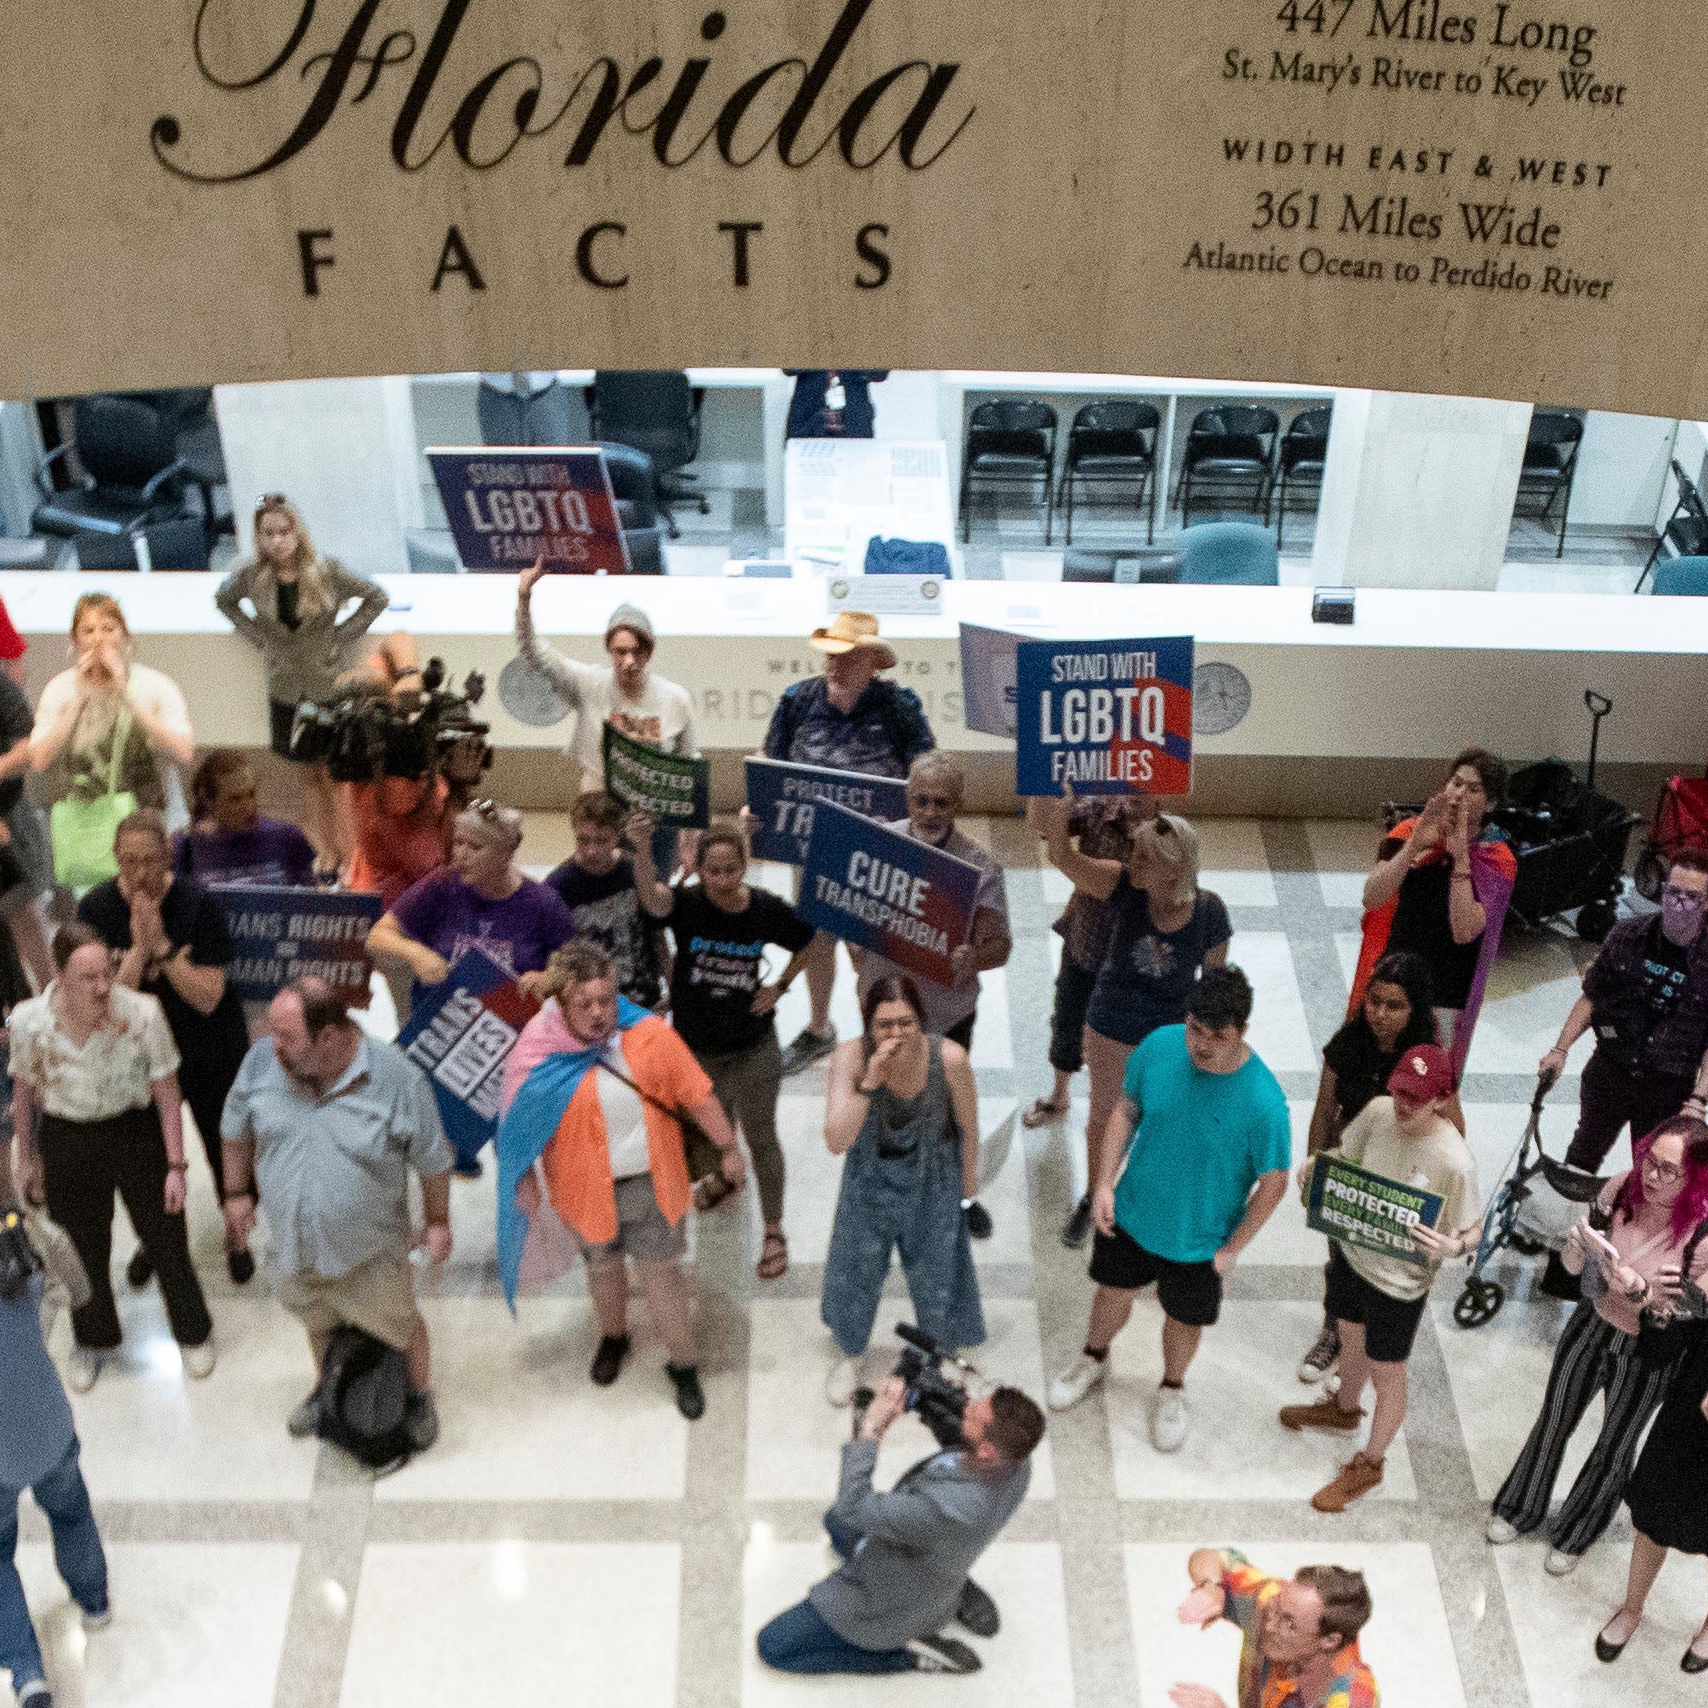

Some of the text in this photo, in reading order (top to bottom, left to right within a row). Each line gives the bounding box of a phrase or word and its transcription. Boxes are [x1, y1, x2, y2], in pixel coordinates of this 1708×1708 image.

[1367, 0, 1476, 46] Miles
[1490, 3, 1594, 67] Long
[153, 0, 976, 184] Florida
[1223, 48, 1628, 107] St. Mary's River to Key West
[1223, 138, 1611, 188] WIDTH EAST & WEST
[1251, 189, 1562, 249] 361 Miles Wide
[298, 223, 892, 296] FACTS
[1182, 242, 1613, 300] Atlantic Ocean to Perdido River
[464, 490, 593, 534] LGBTQ
[490, 535, 589, 561] FAMILIES
[1052, 651, 1157, 683] STAND WITH
[1040, 686, 1167, 747] LGBTQ
[1051, 749, 1154, 782] FAMILIES
[847, 851, 930, 917] CURE
[288, 913, 373, 942] RIGHTS
[816, 874, 949, 956] TRANSPHOBIA
[406, 987, 484, 1070] TRANS
[442, 1016, 512, 1096] LIVES
[1321, 1206, 1416, 1251] RESPECTED
[1324, 1178, 1421, 1227] PROTECTED
